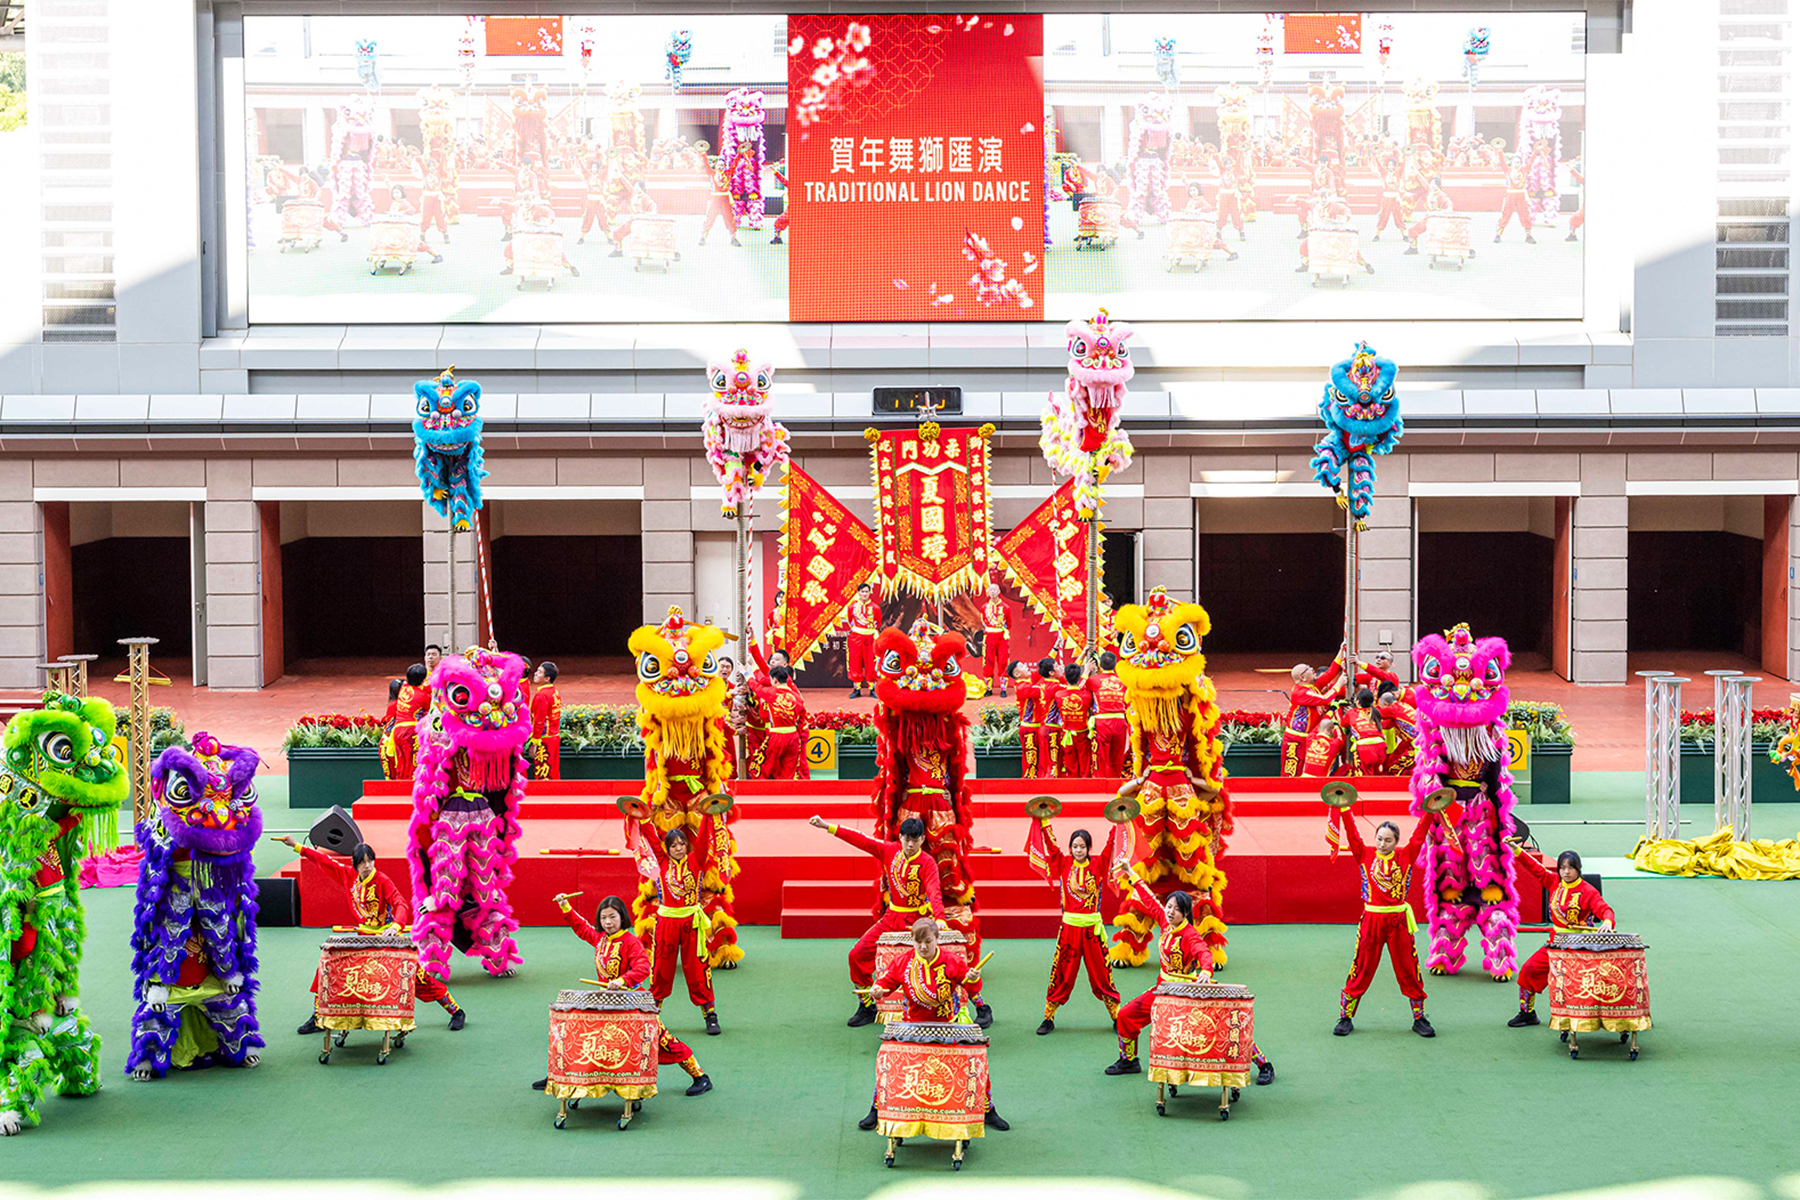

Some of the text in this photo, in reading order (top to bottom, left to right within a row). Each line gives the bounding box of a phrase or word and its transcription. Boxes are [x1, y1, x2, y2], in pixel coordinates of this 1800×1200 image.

[830, 136, 1003, 173] 賀年舞獅匯演
[804, 181, 1031, 202] TRADITIONAL LION DANCE
[921, 475, 949, 565] 夏國璋
[535, 745, 549, 780] 柔功
[811, 742, 823, 758] 4
[1283, 742, 1299, 777] 夏國
[1567, 892, 1582, 925] 夏國
[606, 941, 623, 977] 夏國
[1170, 936, 1184, 973] 夏國
